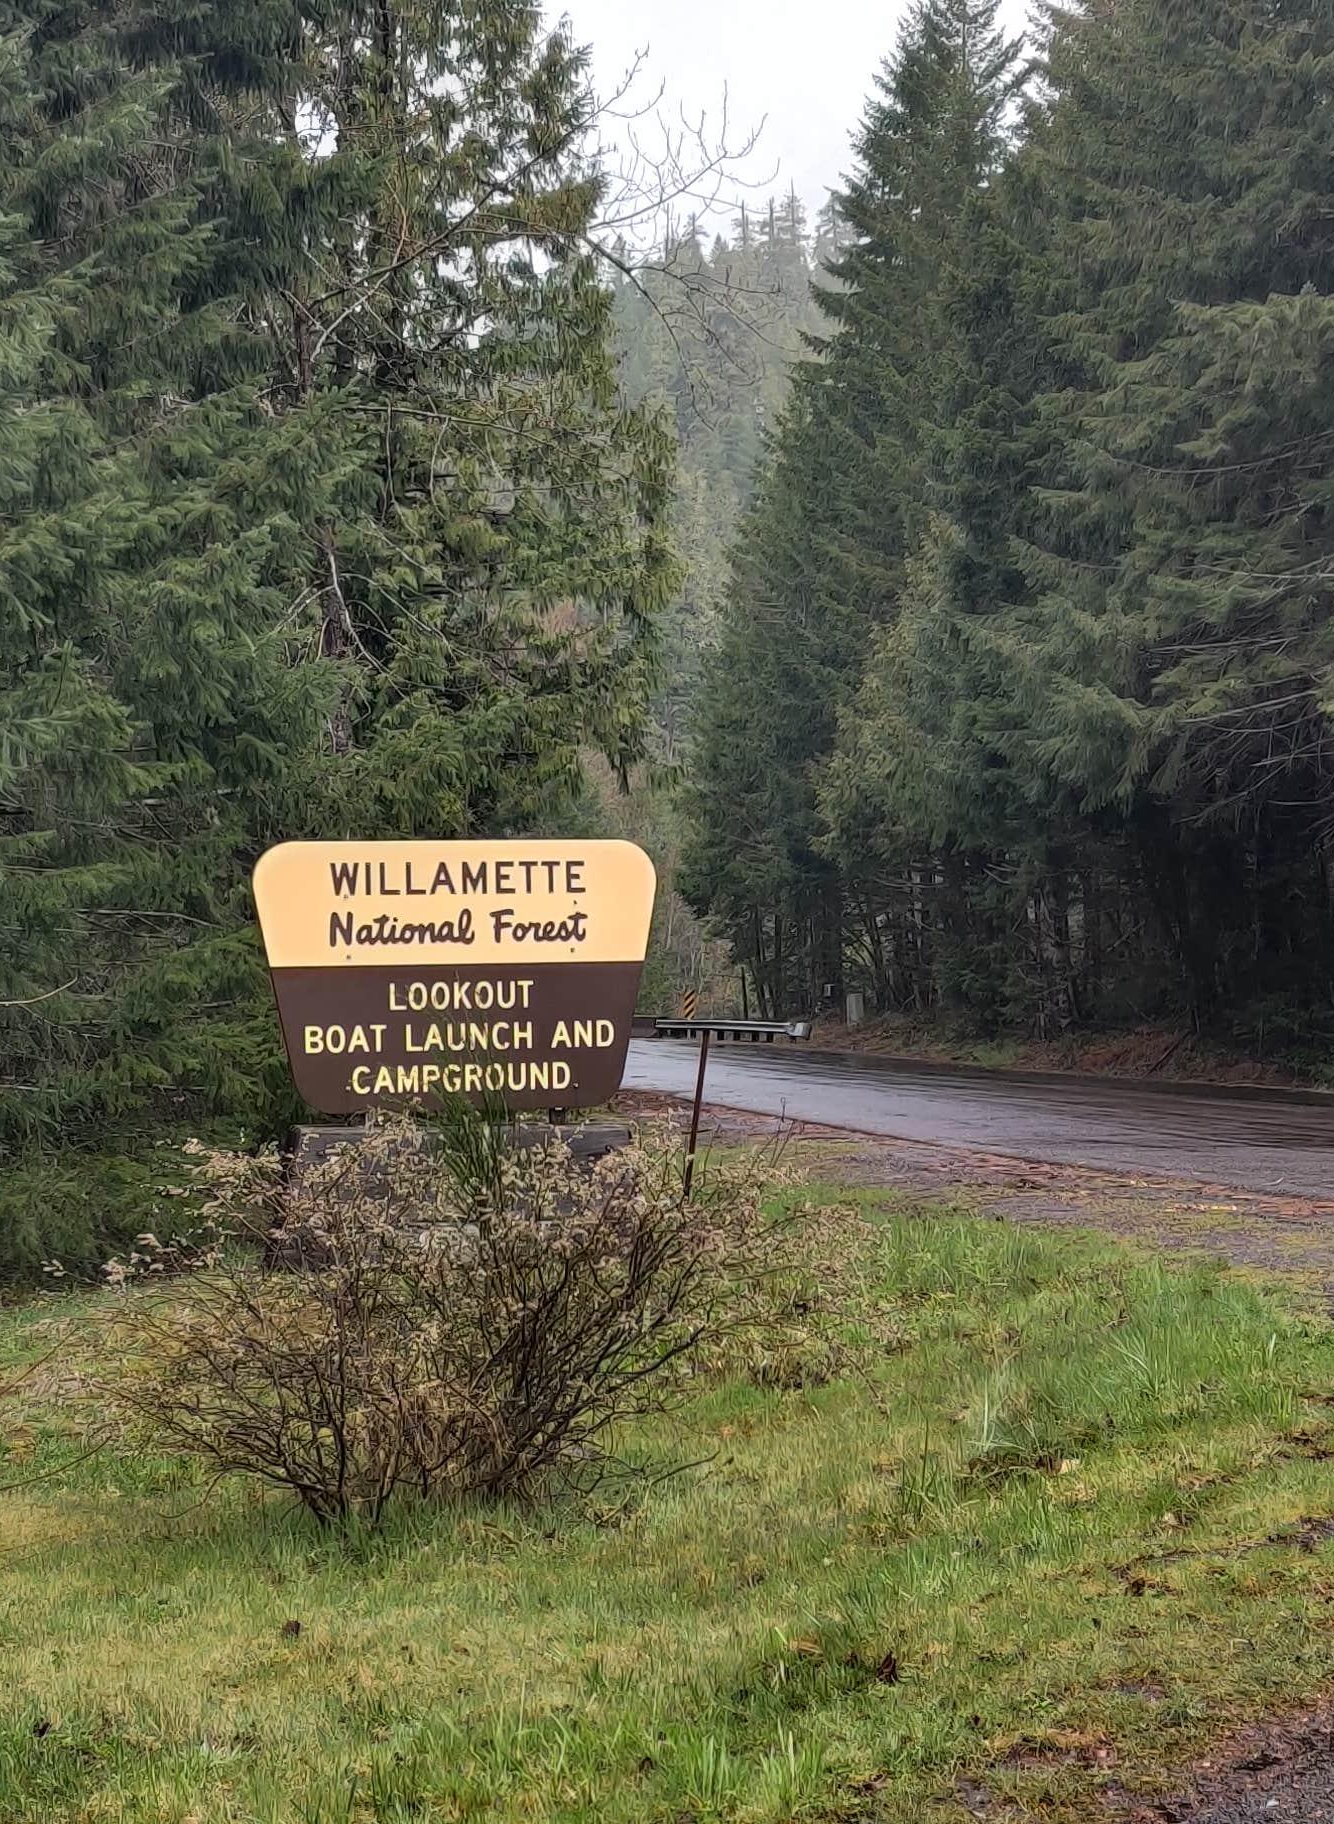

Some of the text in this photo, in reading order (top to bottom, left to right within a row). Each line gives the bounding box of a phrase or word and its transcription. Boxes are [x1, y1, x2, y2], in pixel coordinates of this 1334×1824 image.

[329, 860, 587, 896] WILLAMETTE
[329, 908, 589, 947] National Forest
[388, 979, 534, 1012] LOOKOUT
[304, 1019, 616, 1054] BOAT LAUNCH AND
[351, 1061, 572, 1095] CAMPGROUND
